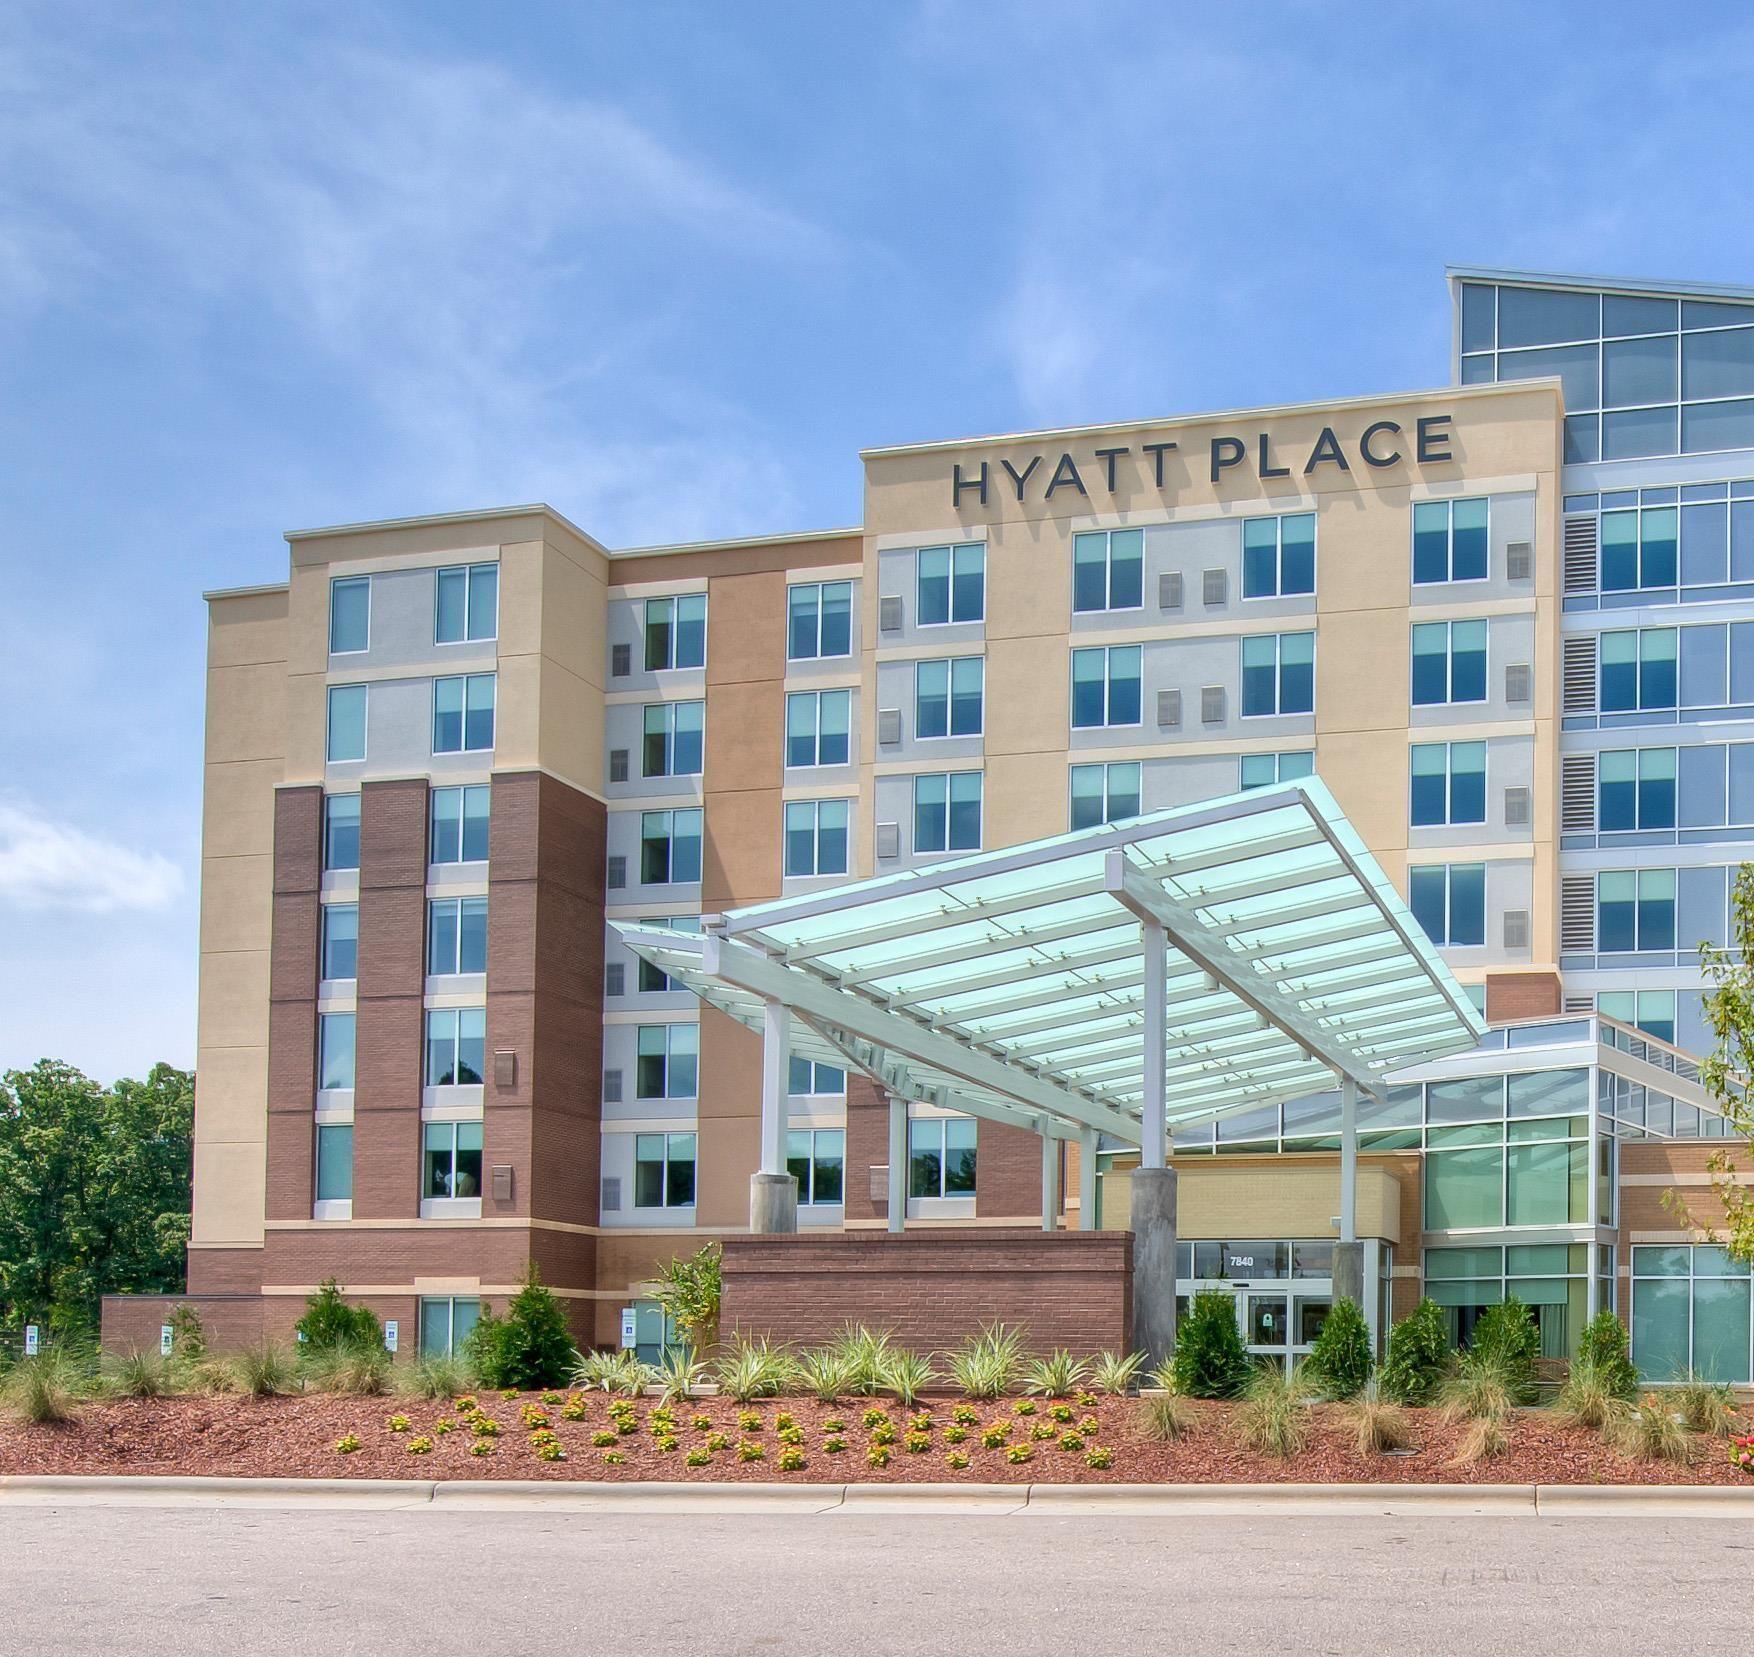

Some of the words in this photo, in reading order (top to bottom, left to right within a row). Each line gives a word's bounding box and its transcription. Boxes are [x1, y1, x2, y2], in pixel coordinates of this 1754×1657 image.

[952, 442, 1178, 508] HYATT
[1210, 415, 1453, 483] PLACE
[1230, 1256, 1254, 1267] 7840
